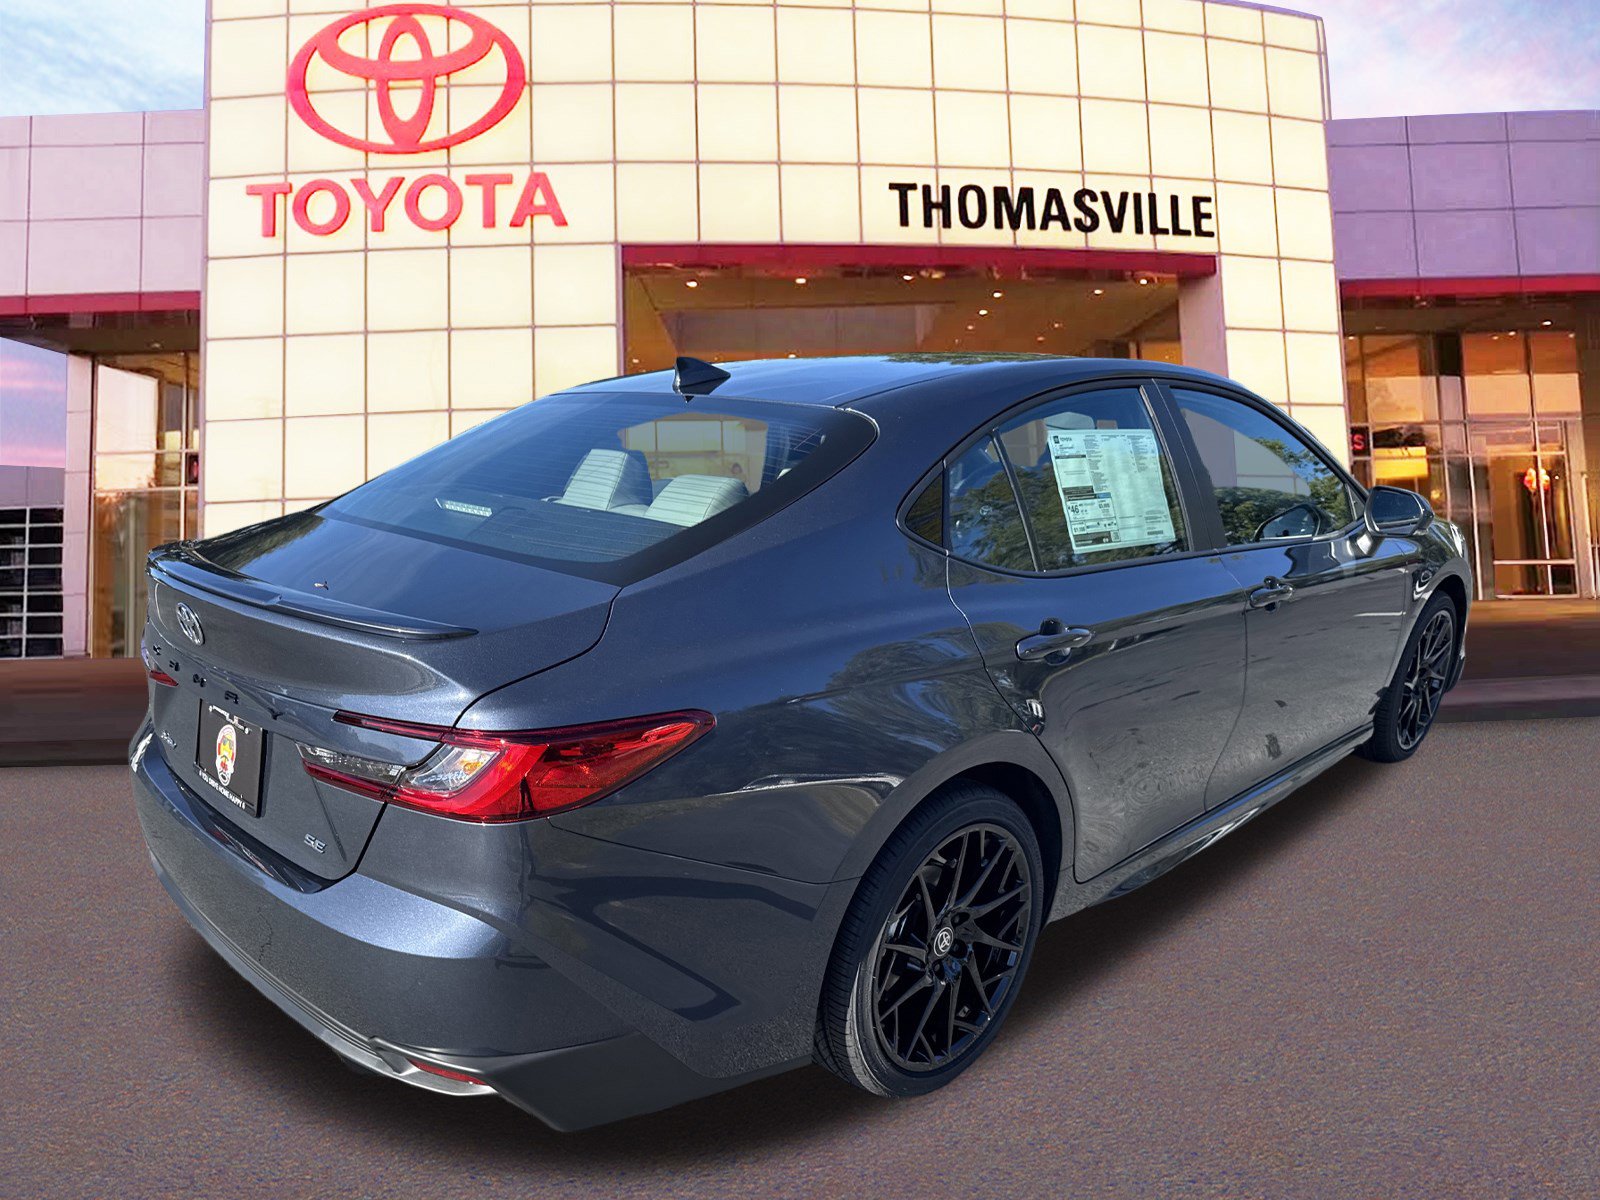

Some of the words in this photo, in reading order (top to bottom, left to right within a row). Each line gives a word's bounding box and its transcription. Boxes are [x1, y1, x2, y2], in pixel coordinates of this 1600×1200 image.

[246, 172, 568, 237] TOYOTA
[889, 183, 1215, 237] THOMASVILLE
[304, 833, 327, 854] SE
